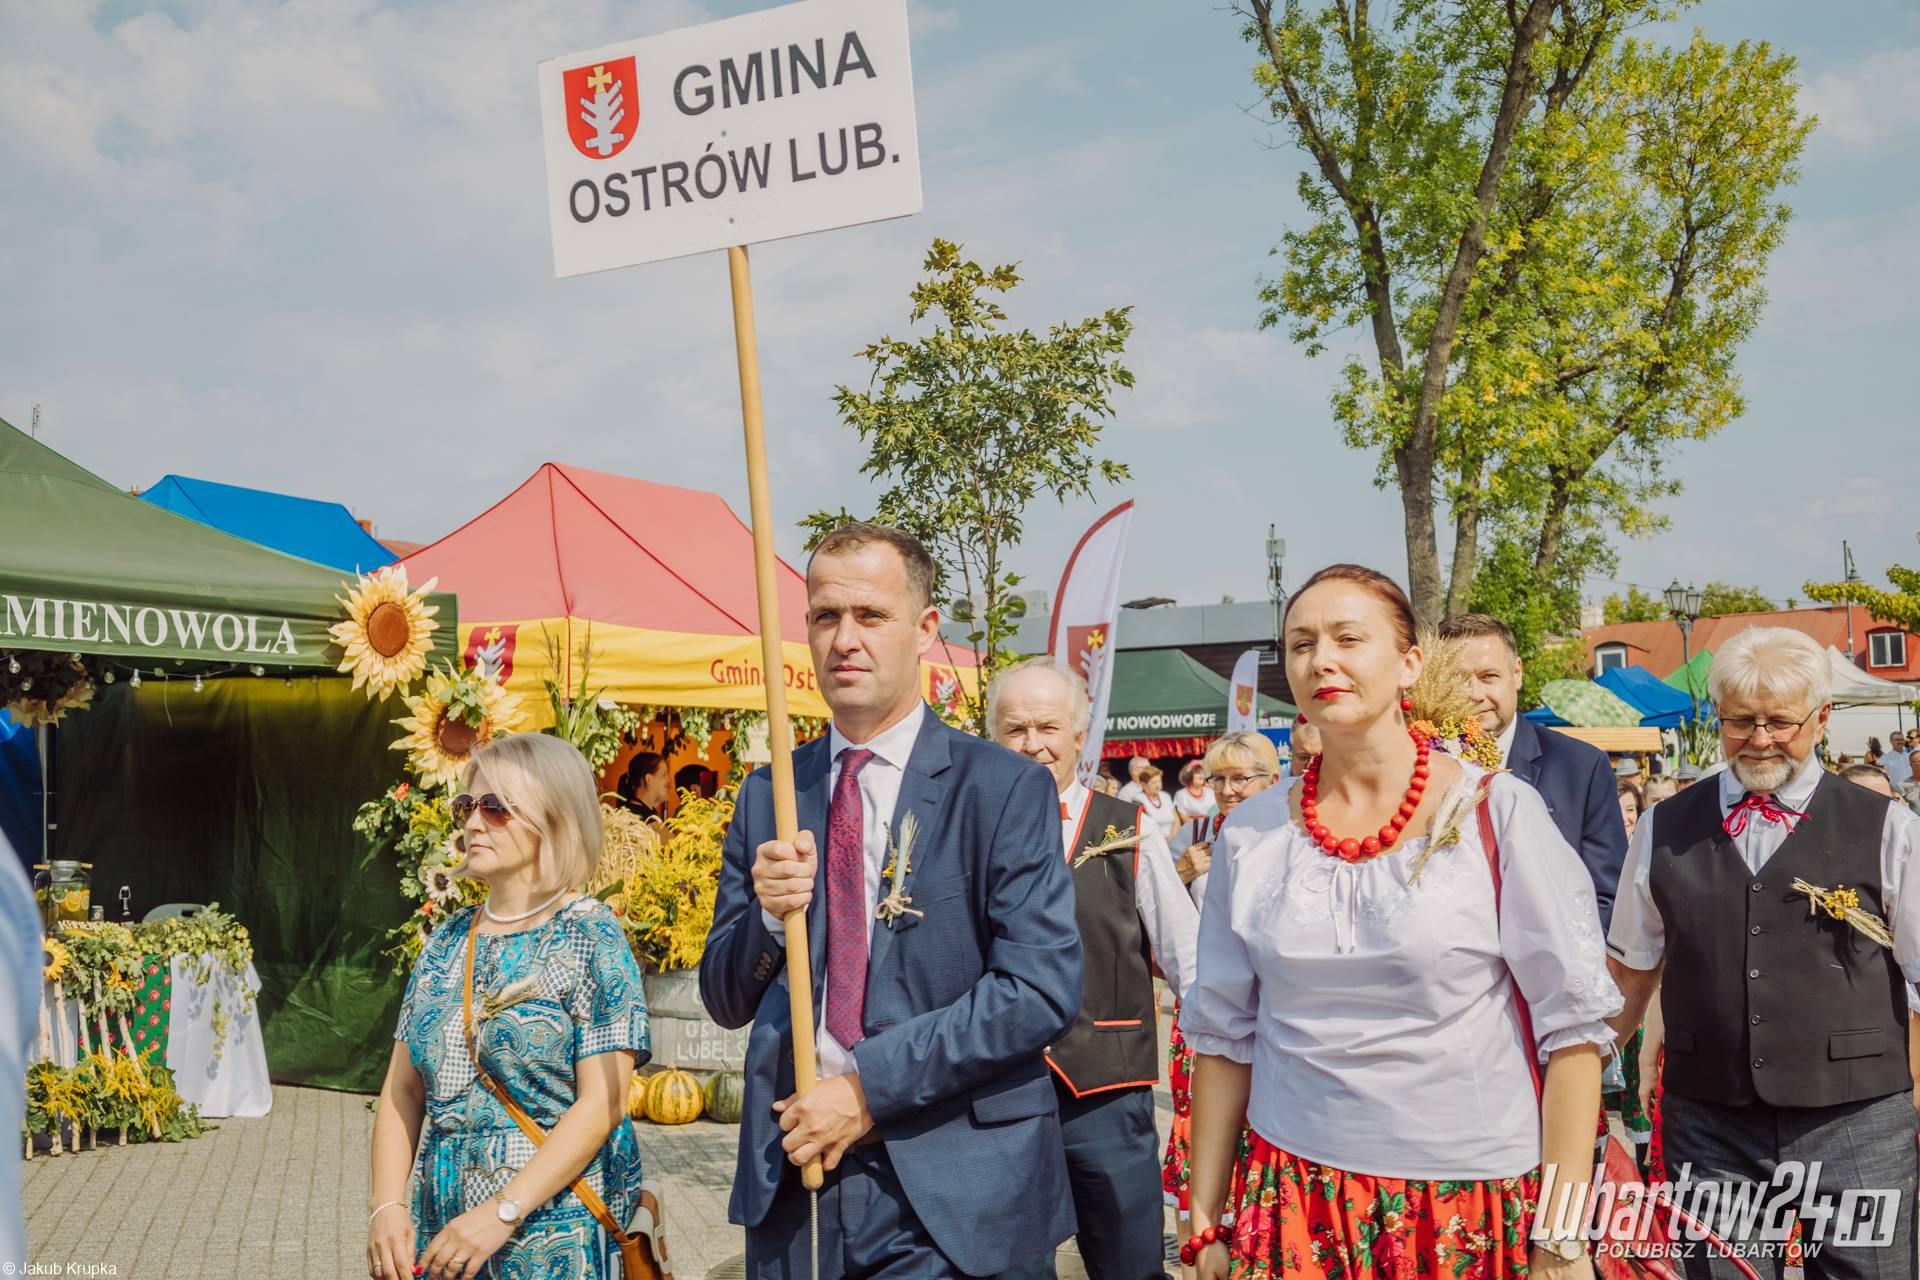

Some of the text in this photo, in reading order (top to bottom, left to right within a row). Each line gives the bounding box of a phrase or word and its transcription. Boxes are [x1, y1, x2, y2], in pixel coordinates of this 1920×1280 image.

[674, 31, 877, 116] GMINA
[569, 122, 900, 223] OSTRÓW LUB.
[0, 594, 298, 655] MIENOWOLA
[711, 658, 767, 686] Gmin
[1117, 713, 1217, 730] NOWODWORZE
